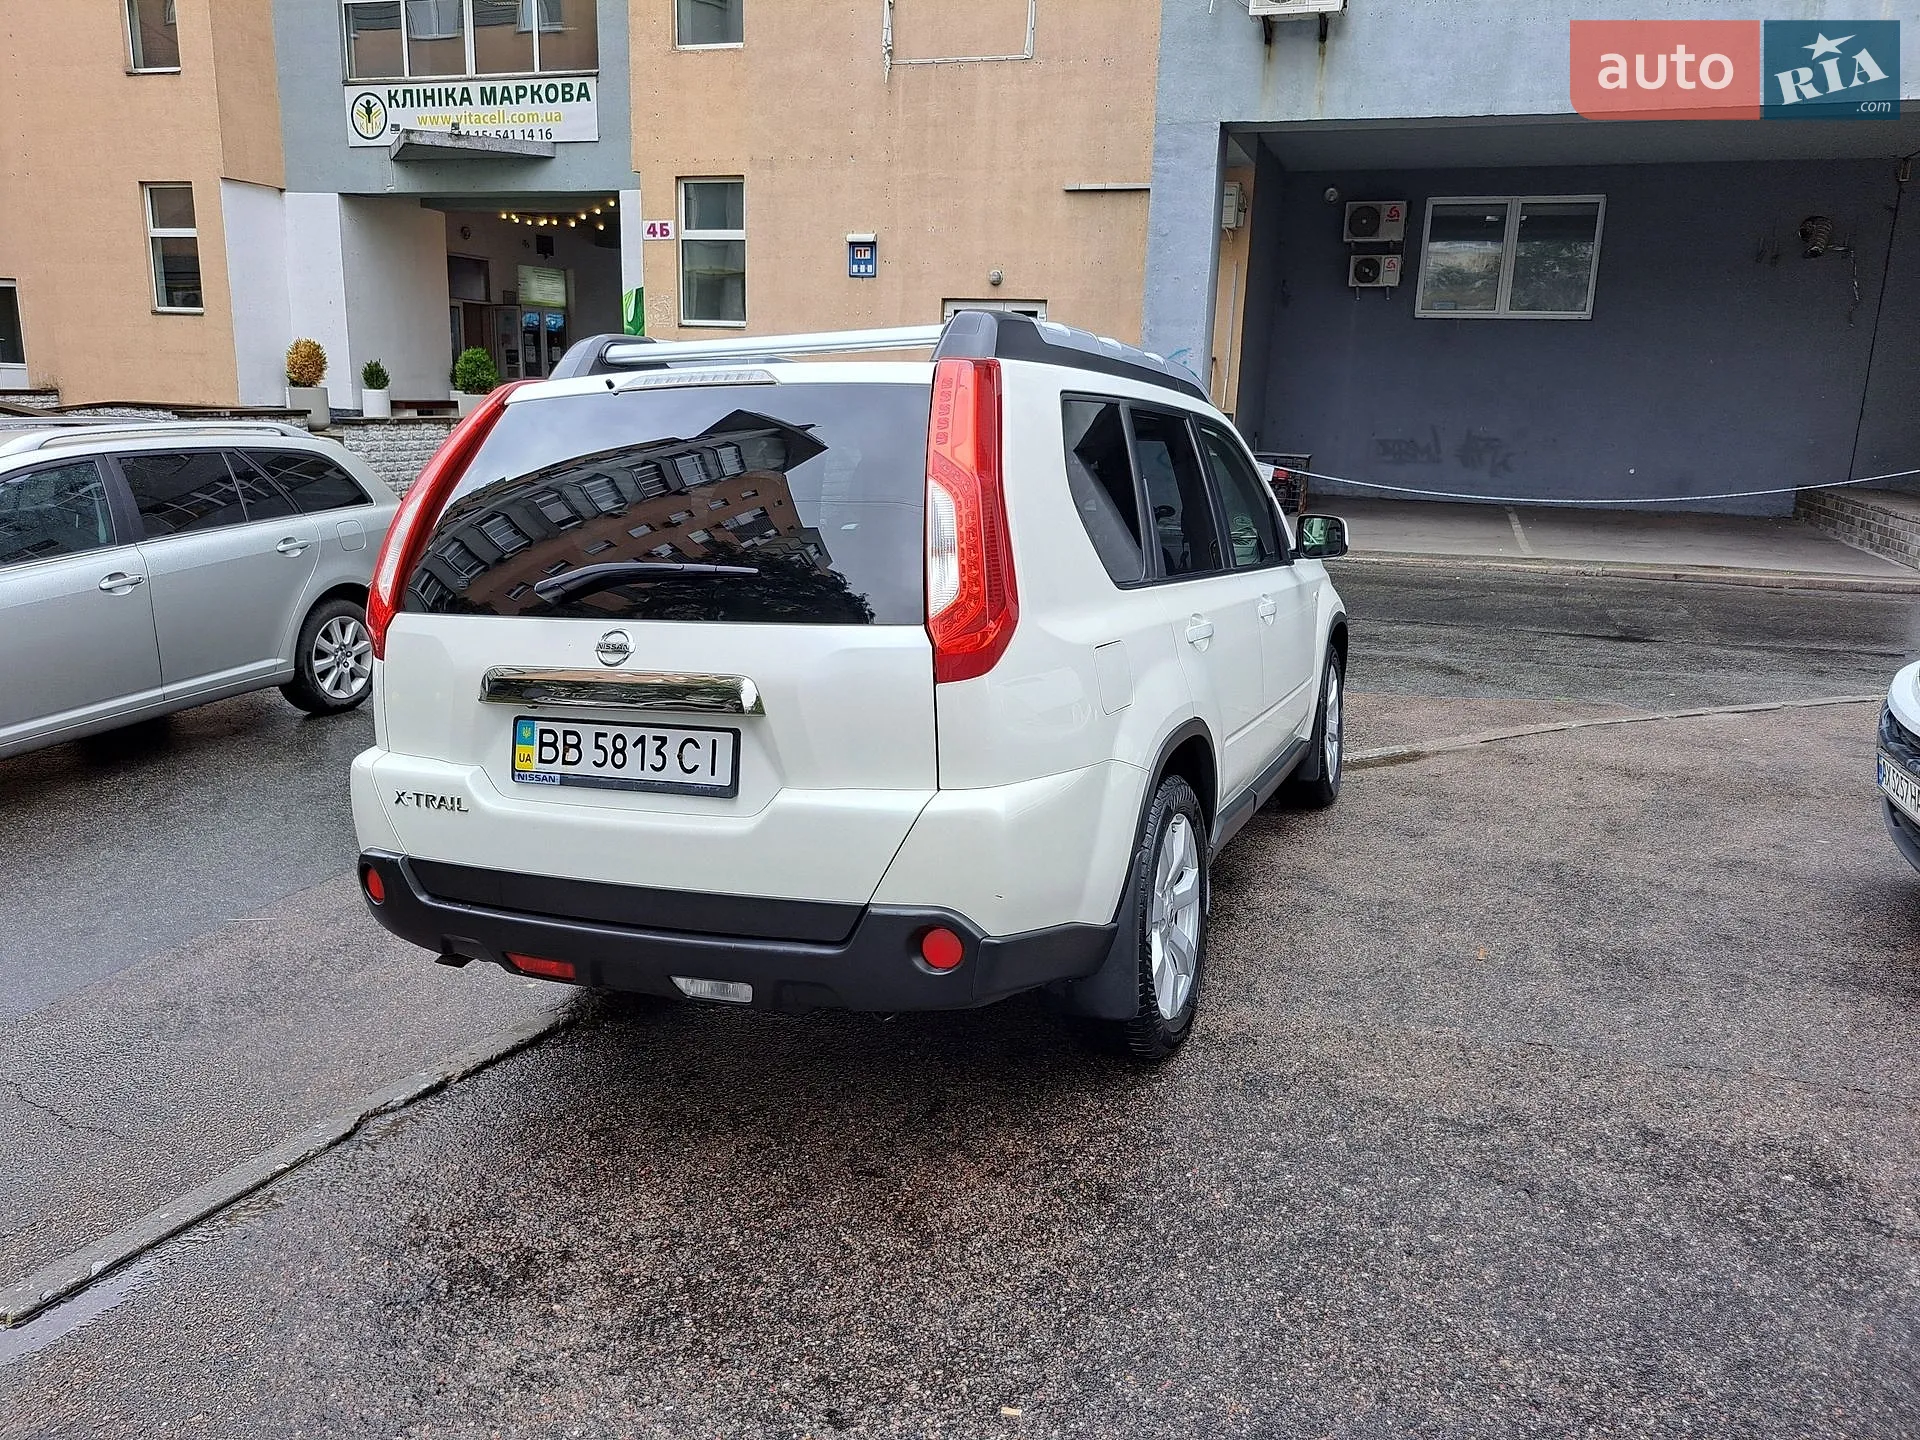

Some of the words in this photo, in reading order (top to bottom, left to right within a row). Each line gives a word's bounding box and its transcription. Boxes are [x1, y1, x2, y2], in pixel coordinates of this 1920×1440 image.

[387, 86, 473, 109] КЛІНІКА
[480, 81, 592, 106] МАРКОВА
[416, 109, 562, 126] www.vitacell.com.ua
[520, 128, 535, 140] 14
[538, 127, 553, 140] 16
[646, 222, 671, 238] 4Б
[597, 642, 630, 651] NISSAN
[518, 752, 532, 764] UA
[537, 728, 583, 766] BB
[592, 731, 668, 773] 5813
[677, 737, 718, 777] CI
[516, 773, 556, 784] NISSAN
[394, 790, 469, 811] X-TRAIL
